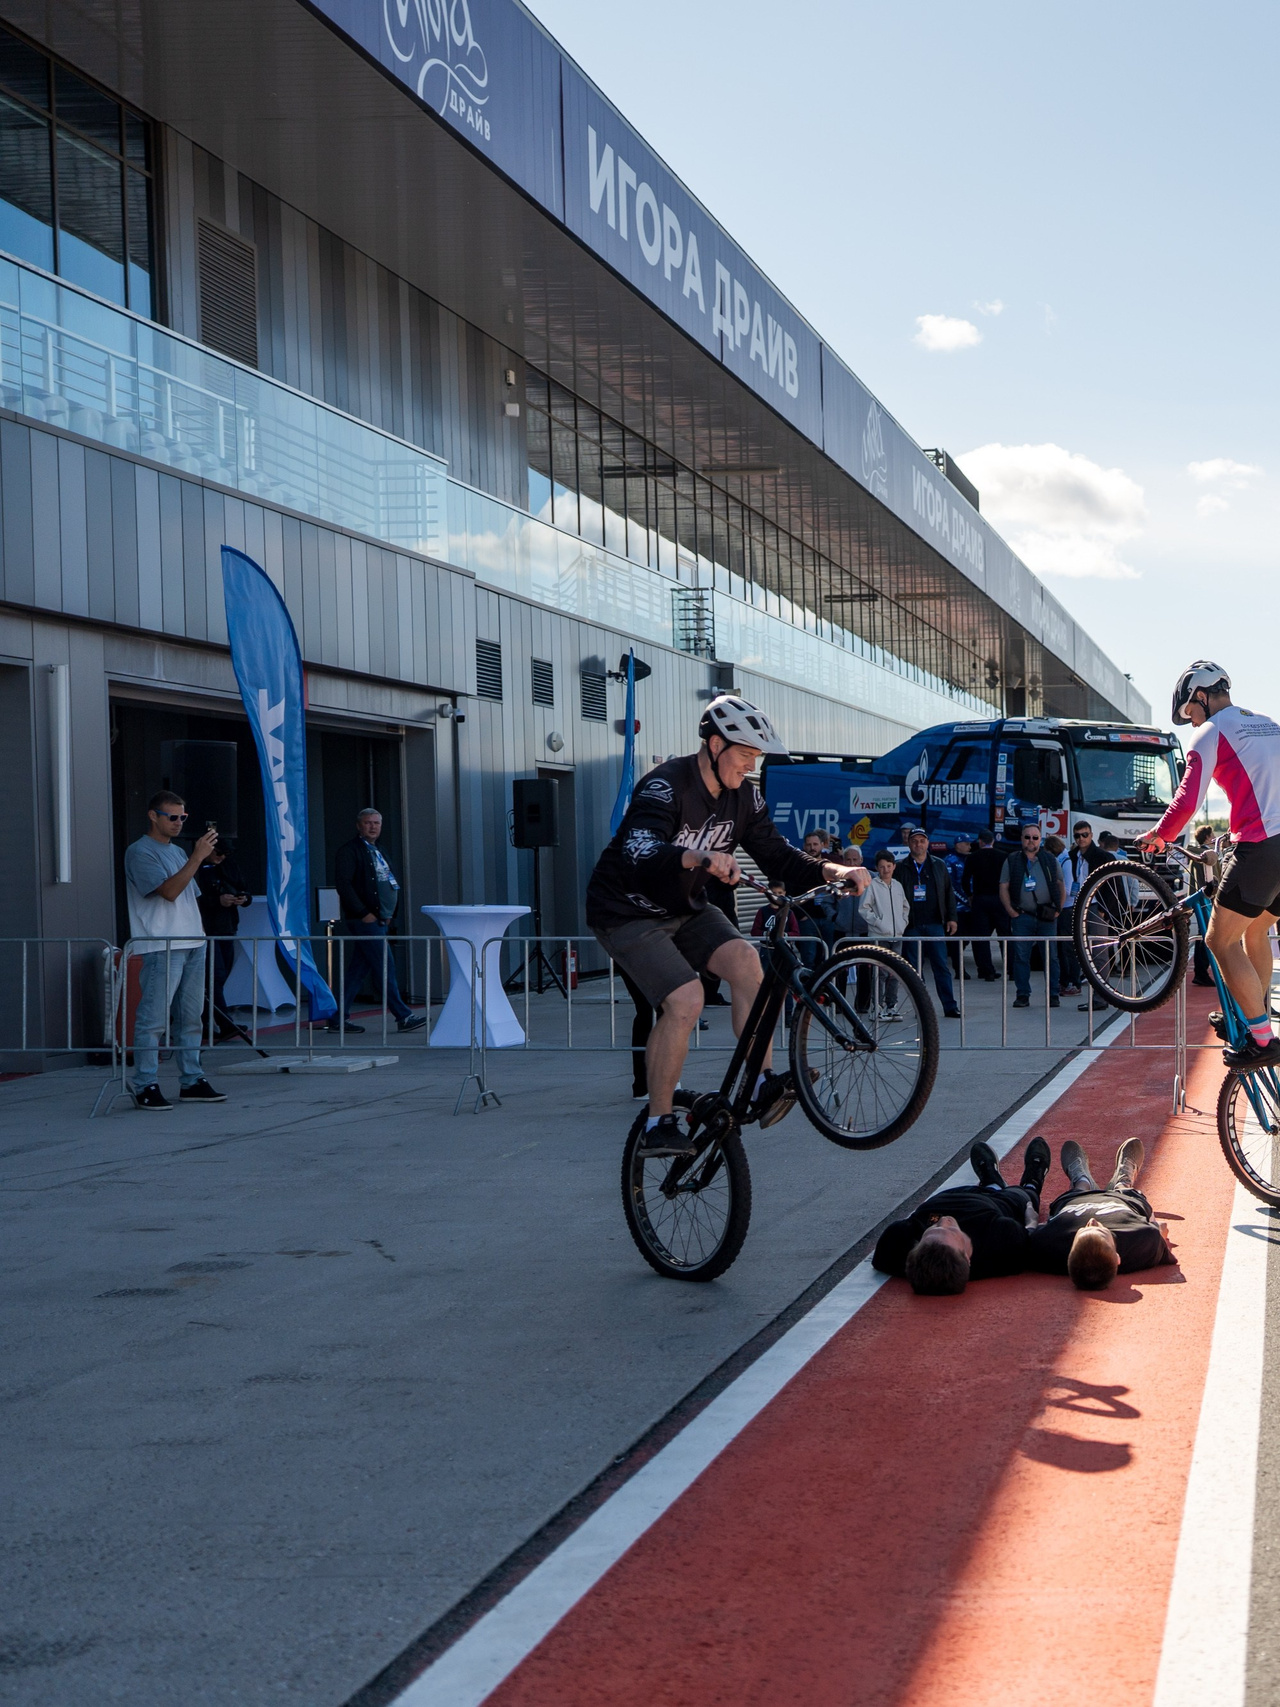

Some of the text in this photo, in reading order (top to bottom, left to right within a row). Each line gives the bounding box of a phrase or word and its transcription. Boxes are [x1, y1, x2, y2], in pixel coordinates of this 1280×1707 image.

[449, 88, 491, 141] ДРАЙВ
[587, 124, 799, 399] ИГОРА ДРАЙВ
[912, 465, 950, 543] ИГОРА
[859, 801, 898, 810] TATNEFT
[927, 782, 987, 806] ГАЗПРОМ
[794, 808, 840, 840] VTB
